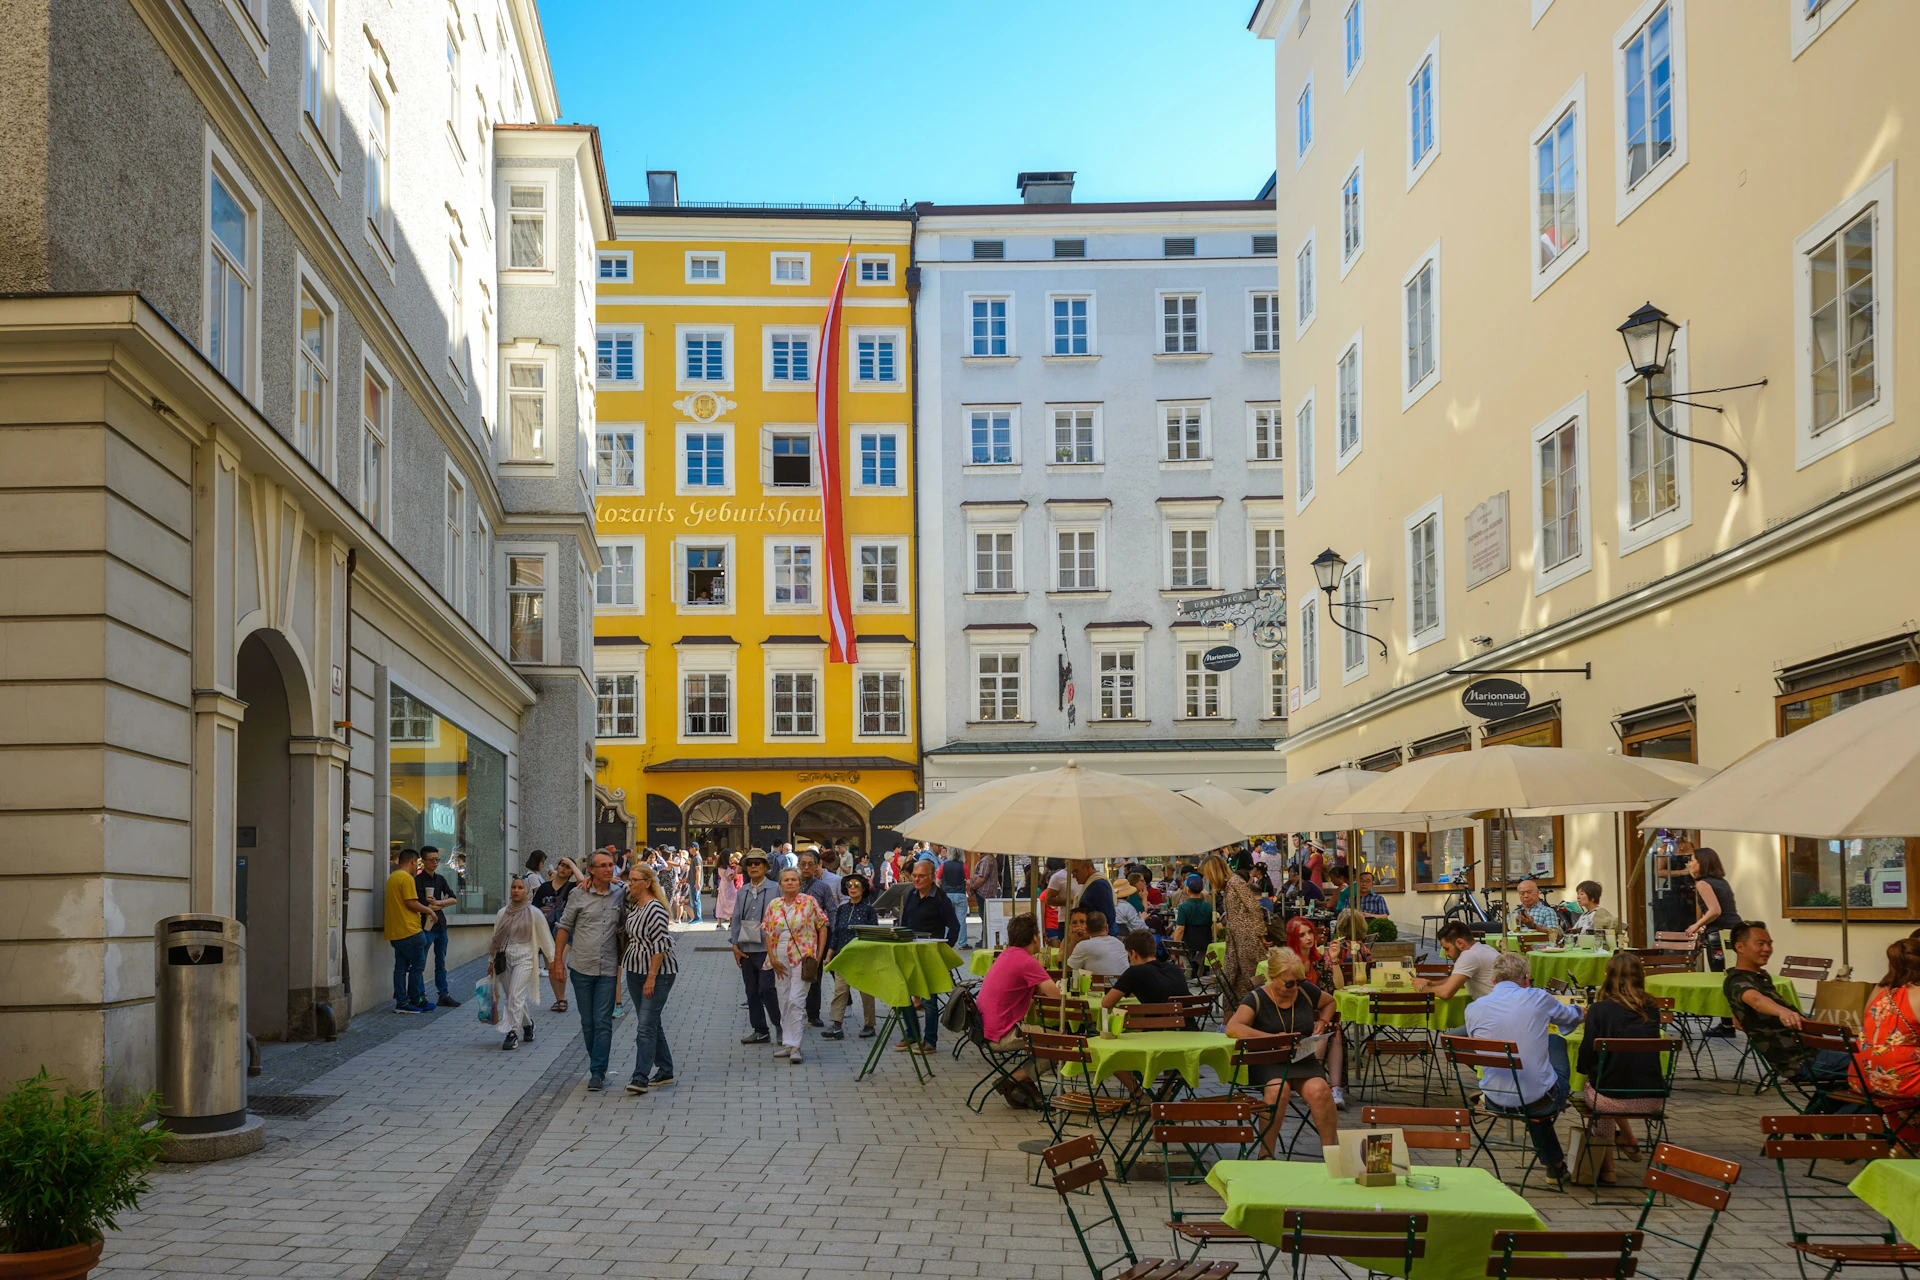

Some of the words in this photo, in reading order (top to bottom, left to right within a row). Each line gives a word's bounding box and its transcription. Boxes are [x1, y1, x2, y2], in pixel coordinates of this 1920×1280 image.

[684, 500, 822, 528] Geburtshau
[1194, 599, 1220, 608] URBAN
[1222, 594, 1248, 604] DECAY
[1203, 651, 1239, 663] Marionnaud
[1464, 689, 1526, 703] Marionnaud
[798, 772, 845, 783] SPAR
[1815, 1008, 1862, 1032] ZARA
